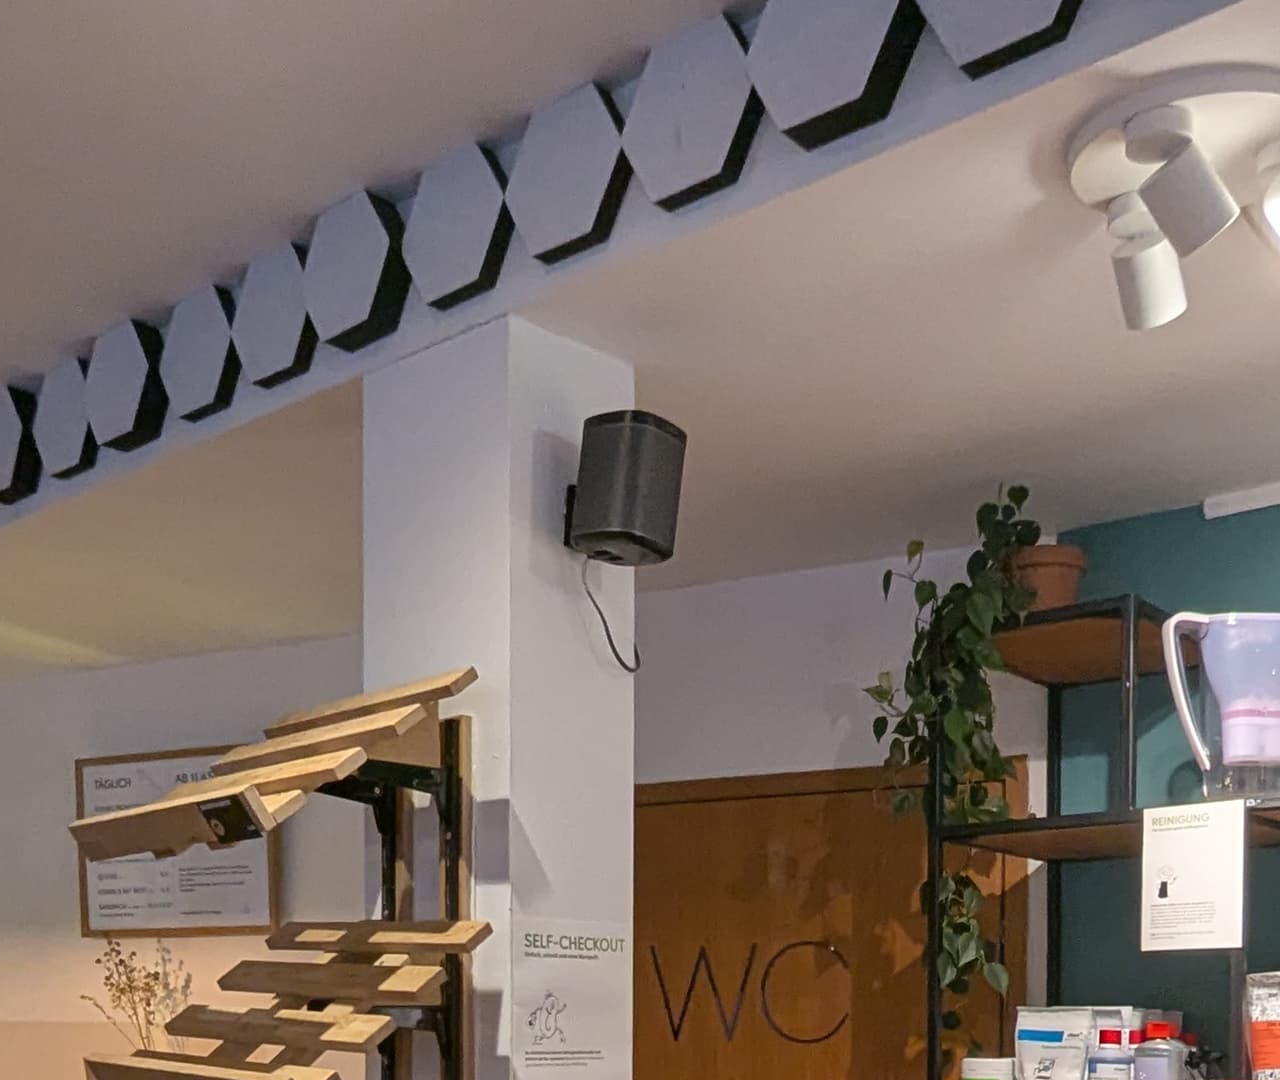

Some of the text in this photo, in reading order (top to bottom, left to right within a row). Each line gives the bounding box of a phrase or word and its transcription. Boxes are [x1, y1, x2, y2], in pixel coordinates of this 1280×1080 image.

[94, 776, 133, 791] TÄGLICH
[1151, 813, 1210, 828] REINIGUNG
[524, 933, 626, 954] SELF-CHECKOUT
[650, 940, 849, 1044] WC
